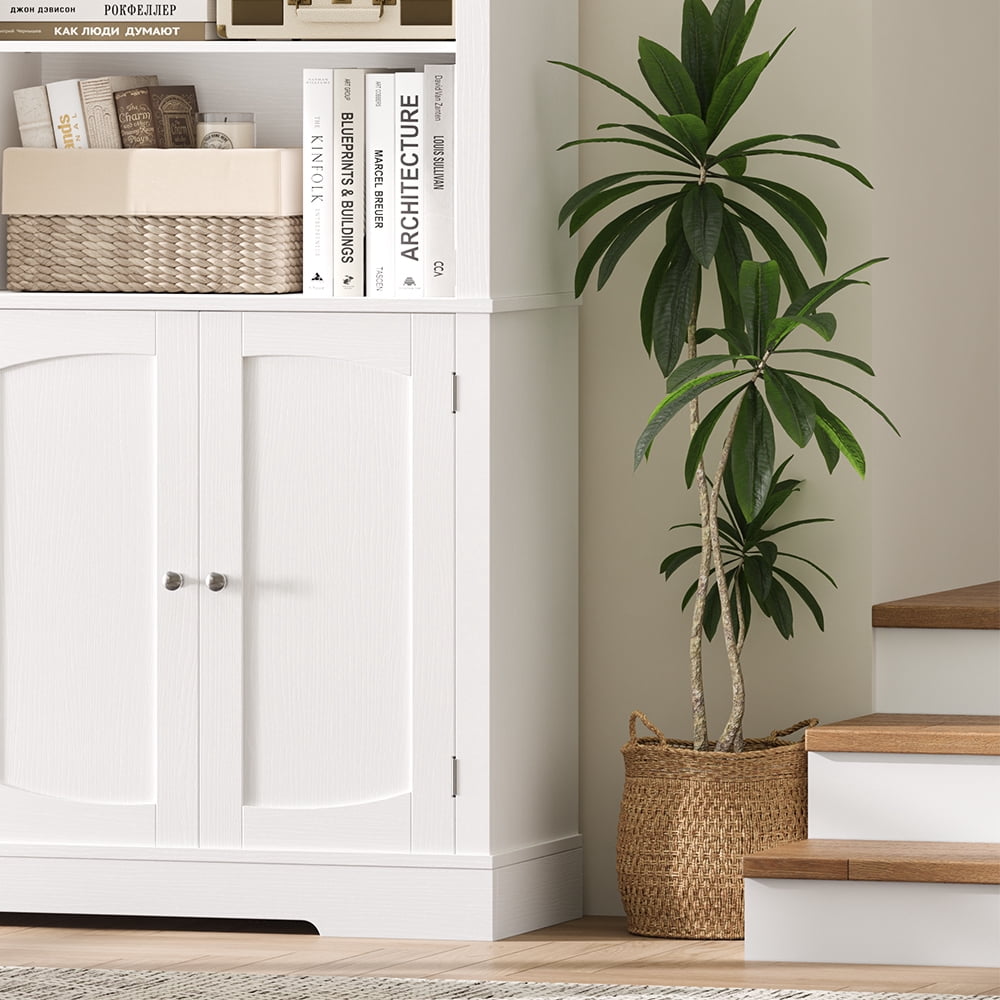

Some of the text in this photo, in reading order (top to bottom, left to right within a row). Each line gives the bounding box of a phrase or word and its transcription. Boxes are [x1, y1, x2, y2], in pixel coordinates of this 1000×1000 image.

[54, 27, 180, 37] КАК ЛЮДИ ДУМАЮТ
[104, 4, 177, 16] РОКФЕЛЛЕР
[119, 112, 151, 123] Charm
[311, 135, 323, 203] KINFOLK
[341, 112, 353, 263] BLUEPRINTS & BUILDINGS
[375, 150, 383, 228] MARCEL BREUER
[400, 95, 419, 261] ARCHITECTURE
[433, 136, 444, 190] LOUIS SULLIVAN
[434, 261, 443, 277] CCA
